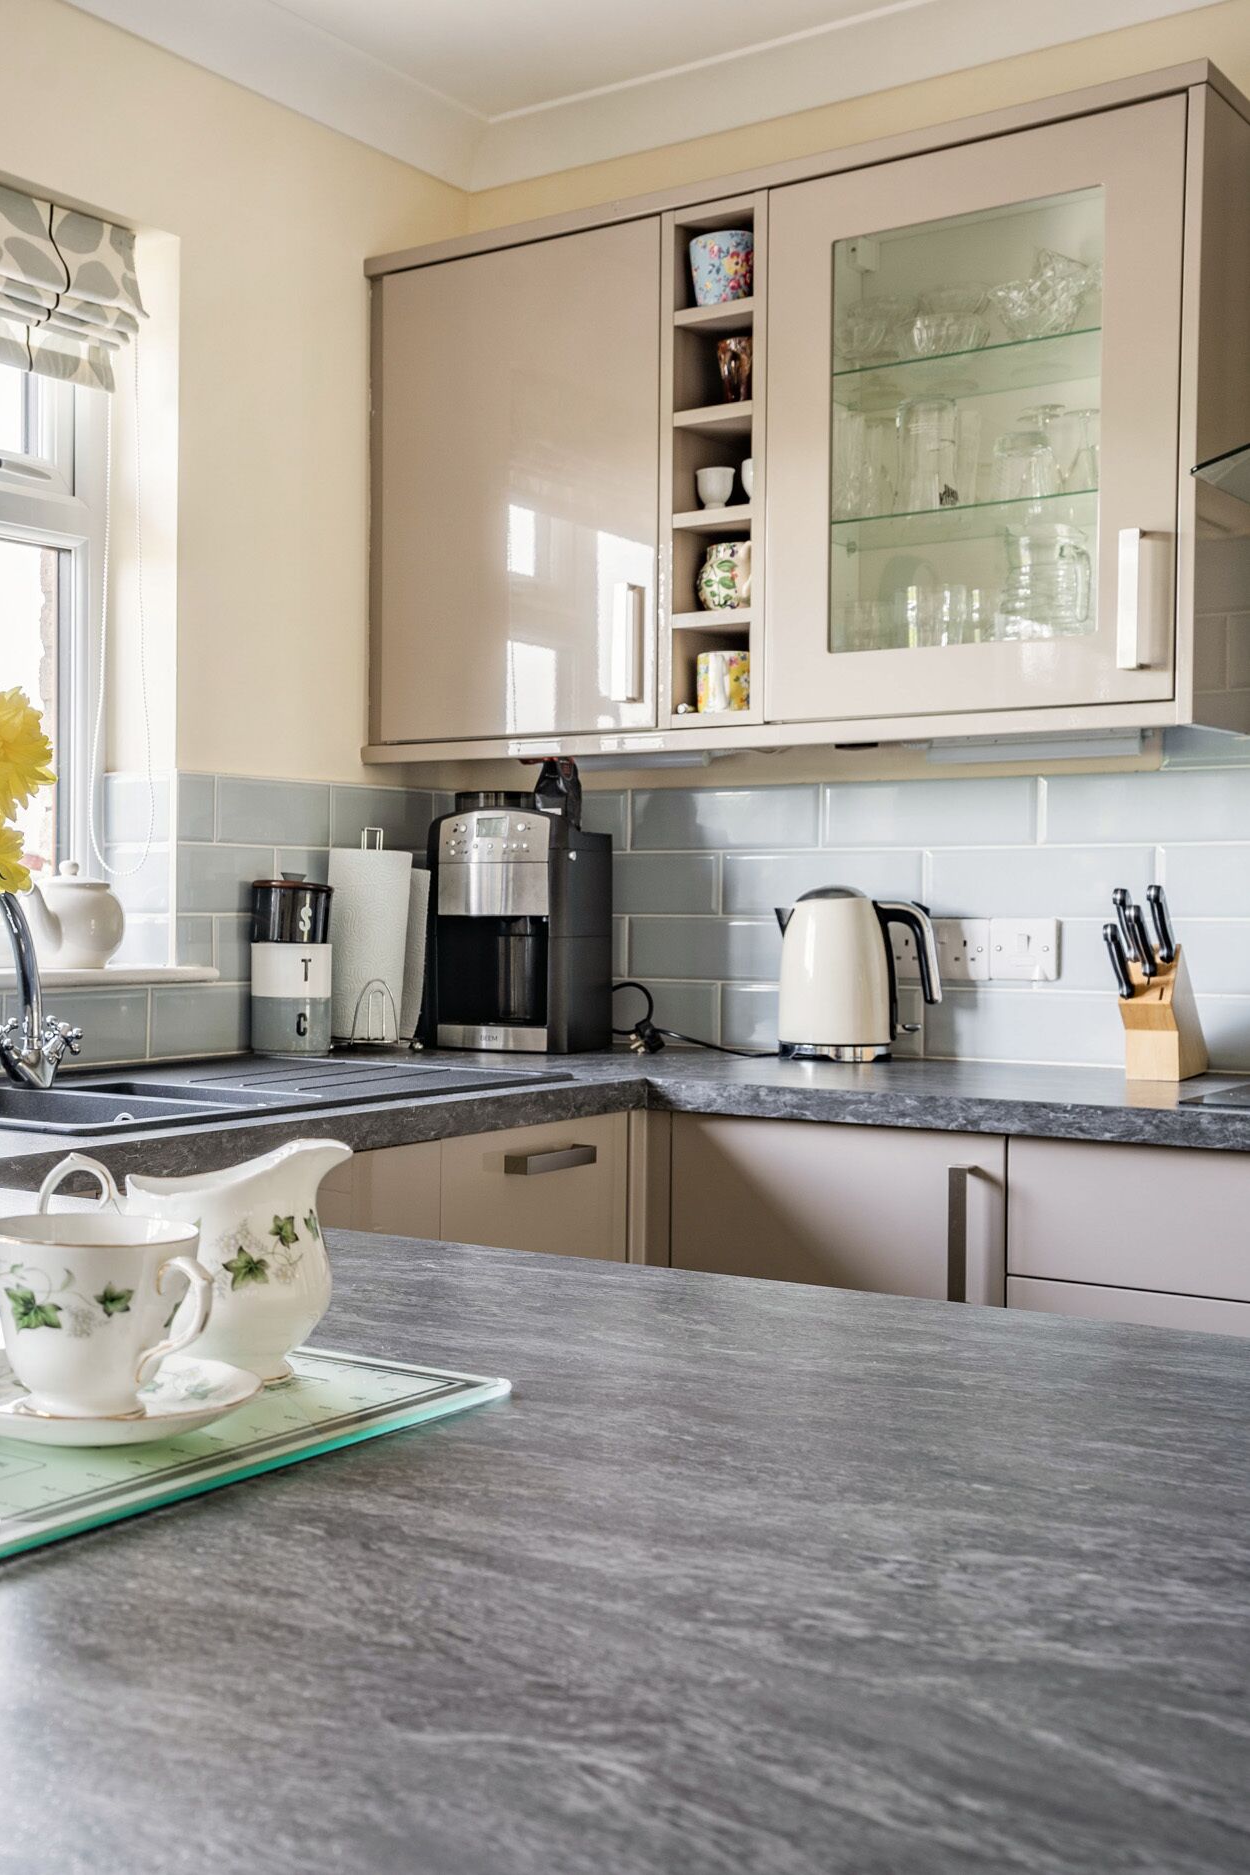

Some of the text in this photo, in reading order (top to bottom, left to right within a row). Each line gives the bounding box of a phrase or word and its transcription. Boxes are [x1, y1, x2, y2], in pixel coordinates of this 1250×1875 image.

[298, 906, 313, 931] S
[301, 958, 312, 982] T
[296, 1012, 308, 1037] C
